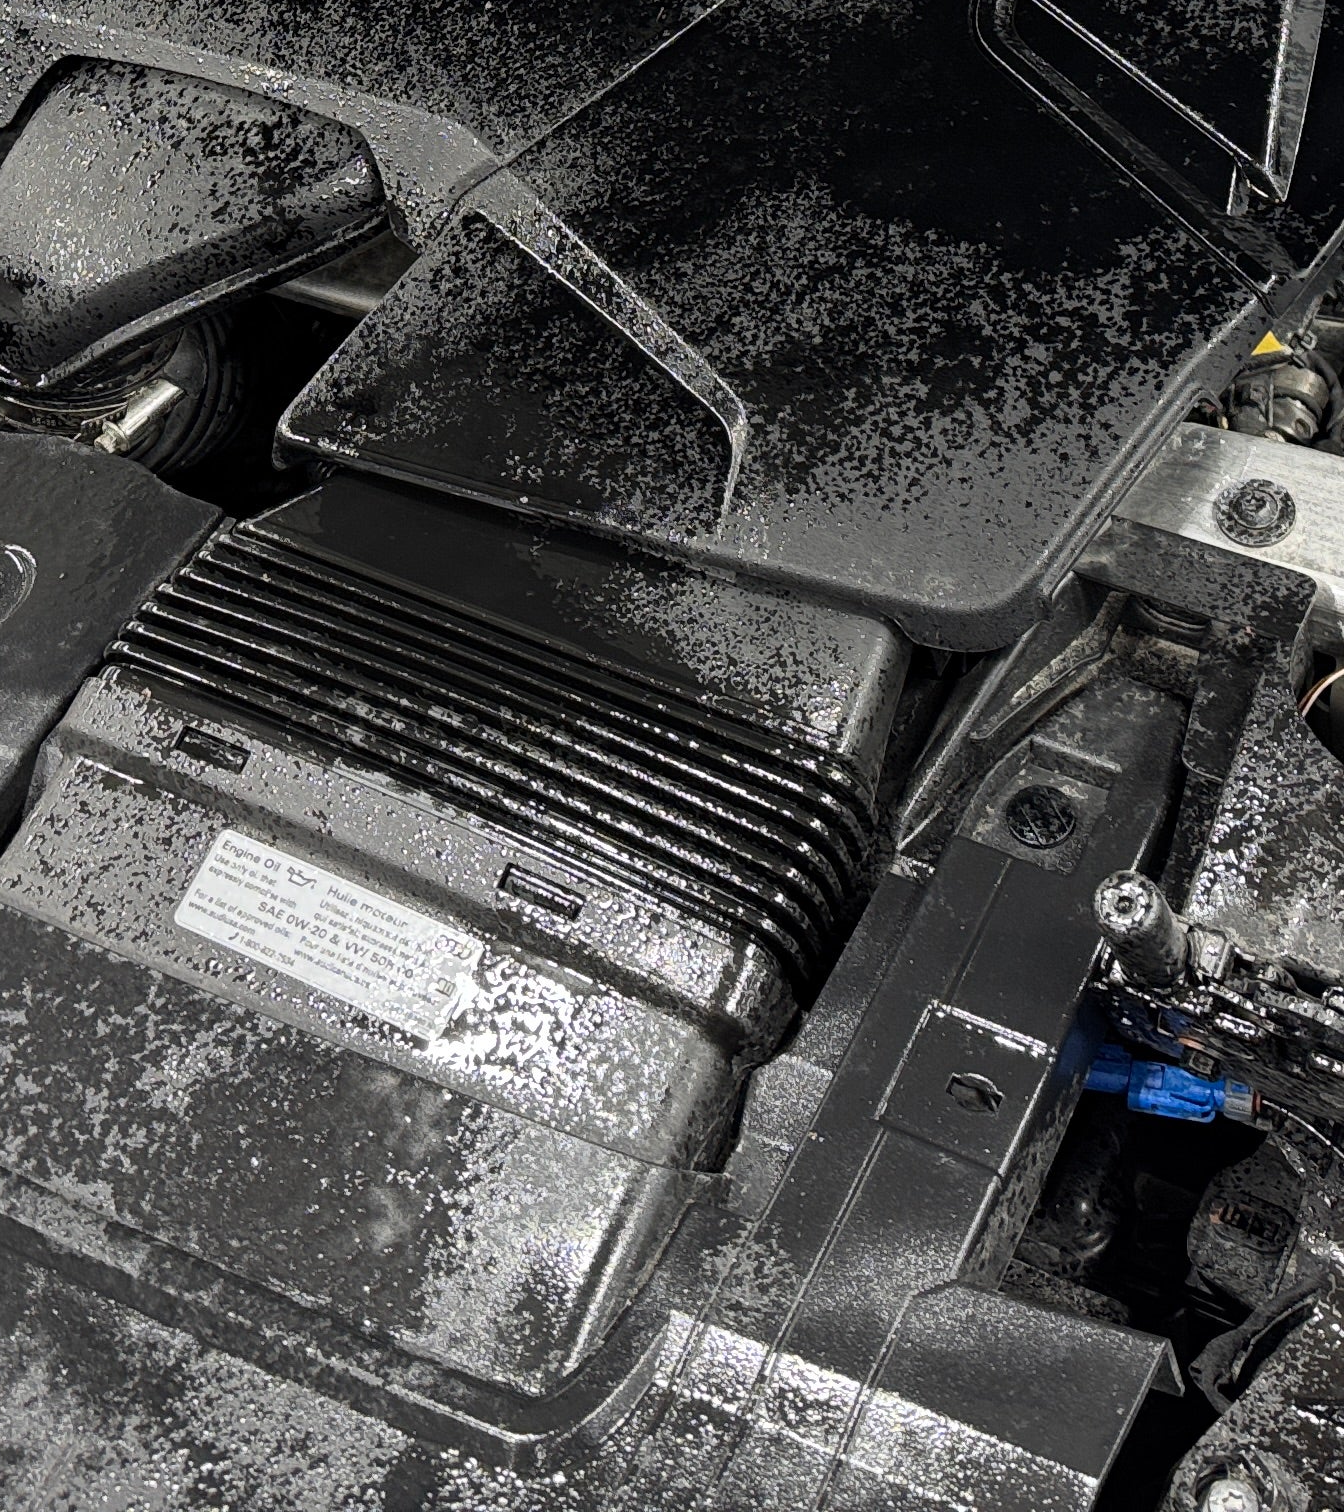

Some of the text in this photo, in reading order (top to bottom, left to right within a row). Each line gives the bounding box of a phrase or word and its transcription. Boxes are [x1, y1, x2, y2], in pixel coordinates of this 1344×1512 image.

[222, 840, 282, 872] Engine Oil
[257, 901, 286, 920] SAE
[286, 914, 327, 939] 0W-20
[329, 934, 340, 946] &
[327, 886, 409, 928] Huile moteur
